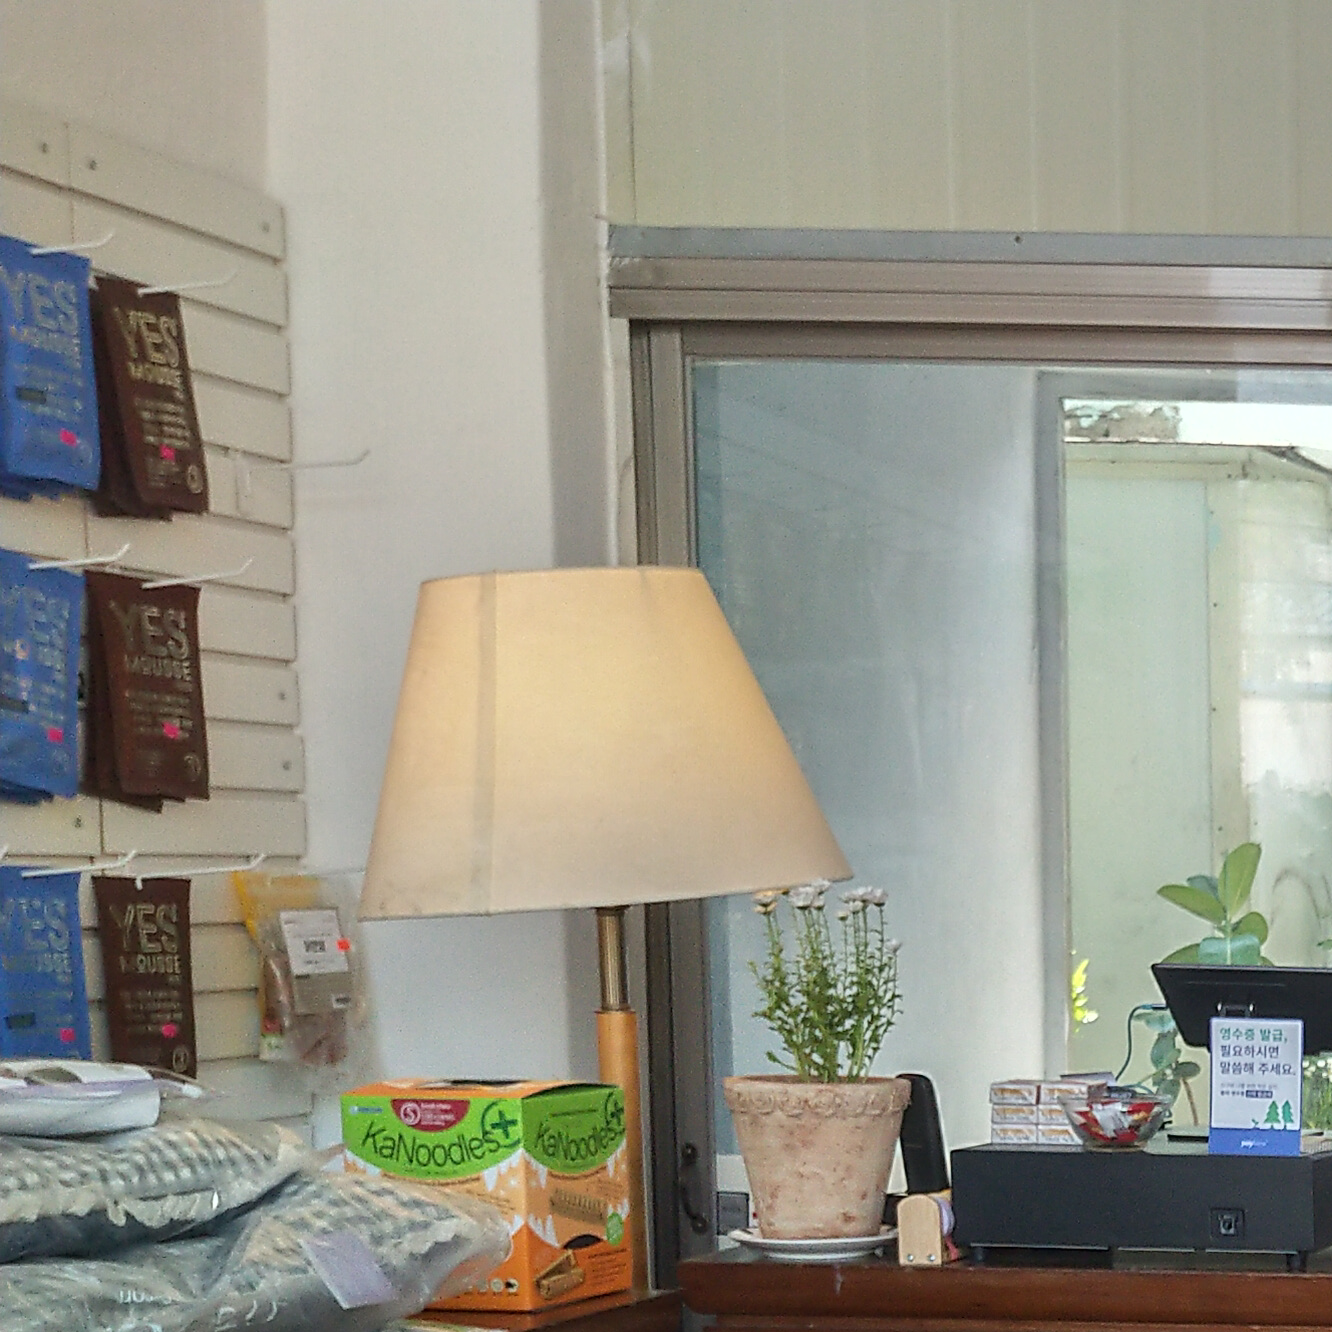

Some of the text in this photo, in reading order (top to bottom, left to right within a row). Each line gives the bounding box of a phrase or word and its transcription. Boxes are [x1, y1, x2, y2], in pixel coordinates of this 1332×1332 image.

[116, 903, 180, 955] YES
[1220, 1027, 1255, 1041] 영수증
[1220, 1045, 1279, 1059] 필요하시면
[1220, 1061, 1296, 1076] 말씀해 주세요.
[361, 1120, 500, 1169] KaNoodles
